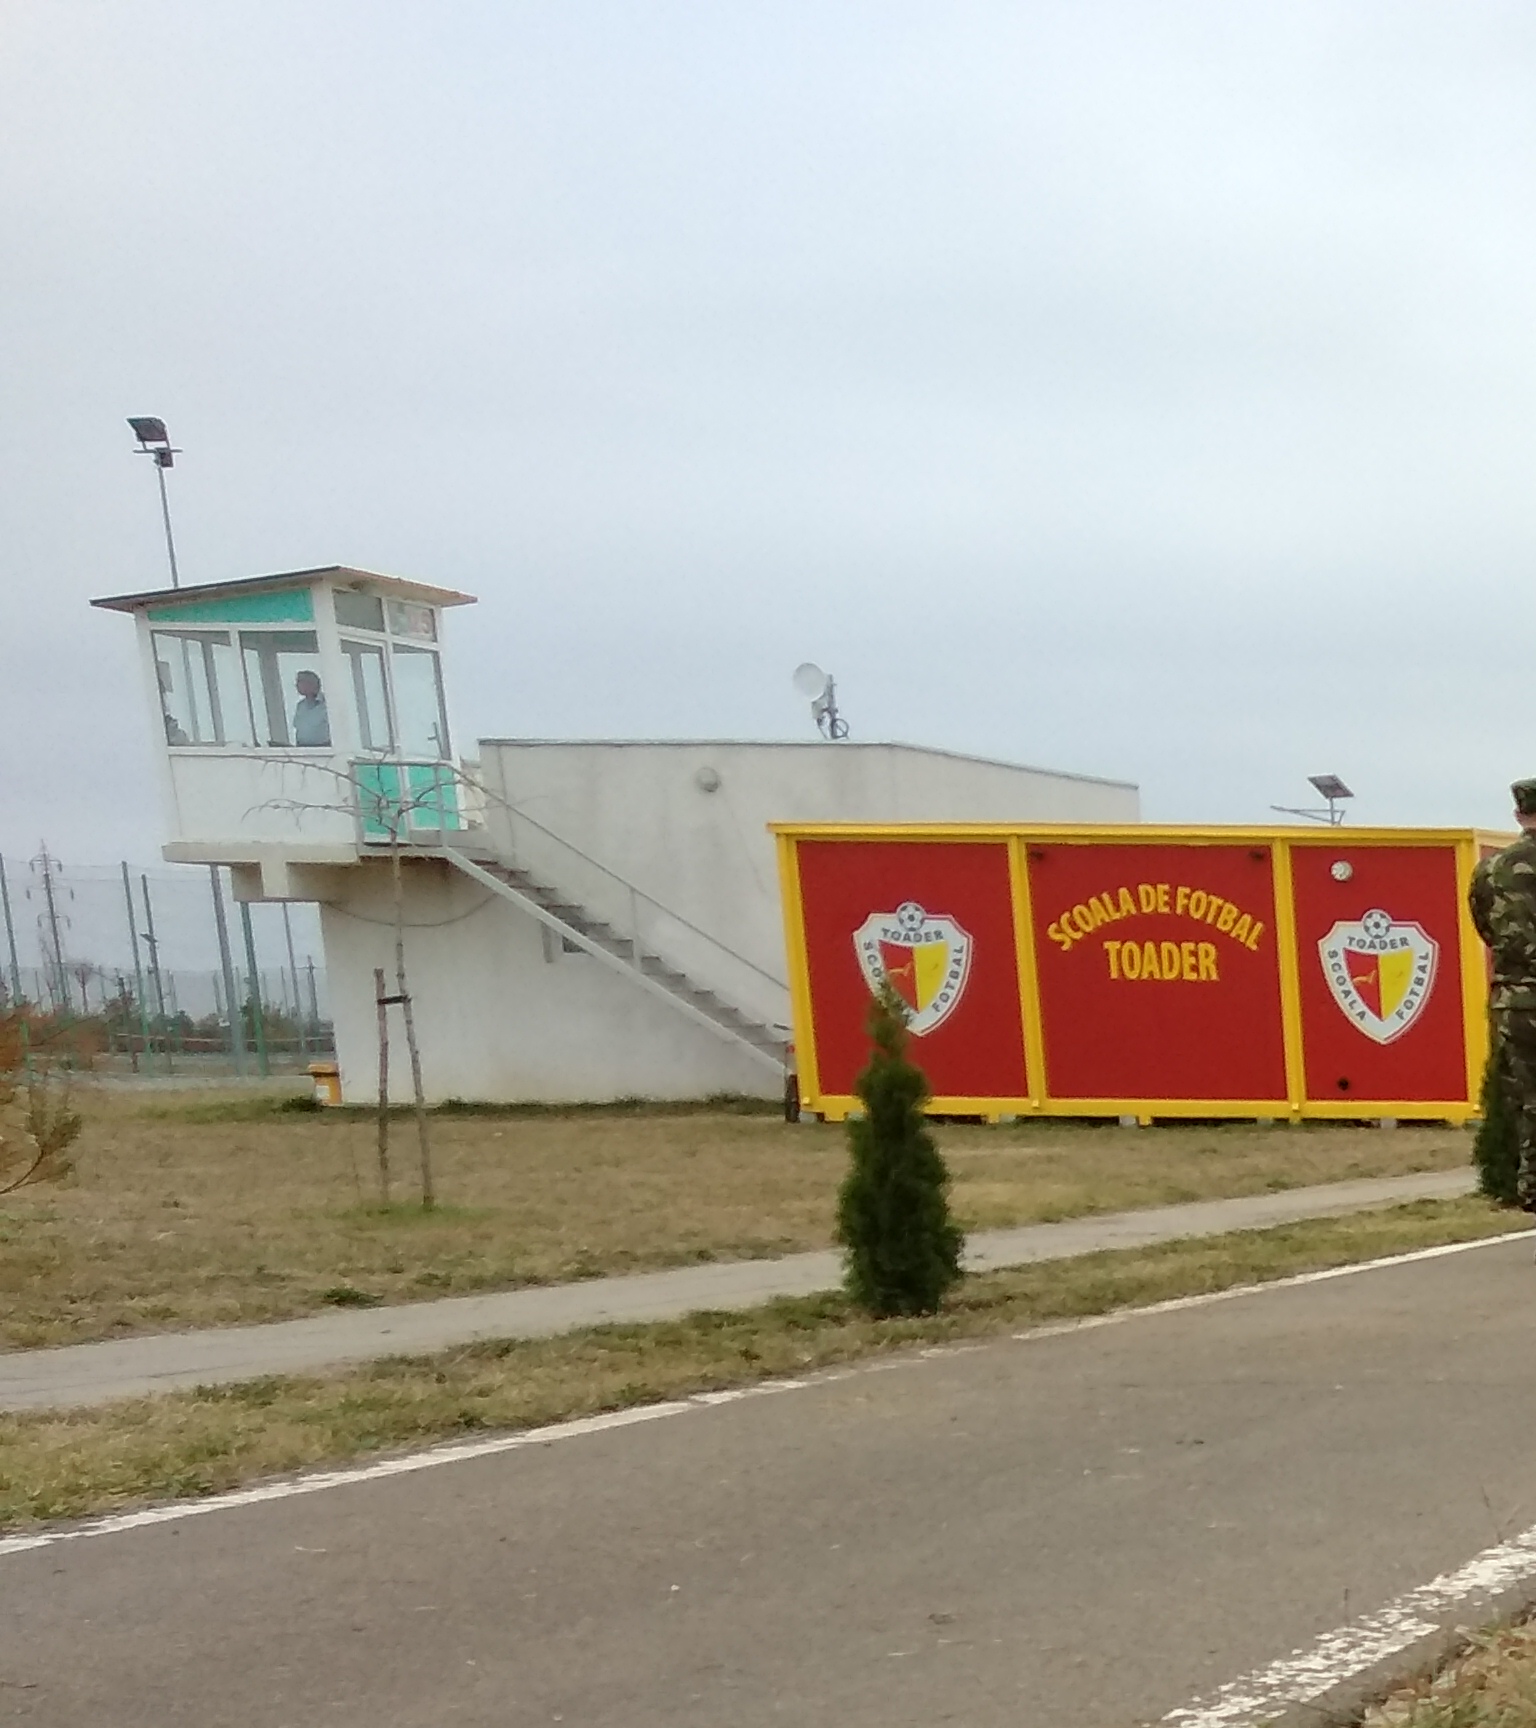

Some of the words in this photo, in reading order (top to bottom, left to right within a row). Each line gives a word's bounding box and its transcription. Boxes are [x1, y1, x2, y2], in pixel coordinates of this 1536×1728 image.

[881, 926, 944, 943] TOADER
[1138, 883, 1171, 914] DE
[1176, 886, 1265, 951] FOTBAL
[1347, 936, 1410, 951] TOADER
[932, 945, 964, 1012] FOTBAL
[1103, 940, 1220, 981] TOADER
[1328, 949, 1367, 1021] SCOALA
[1395, 951, 1430, 1020] FOTBAL
